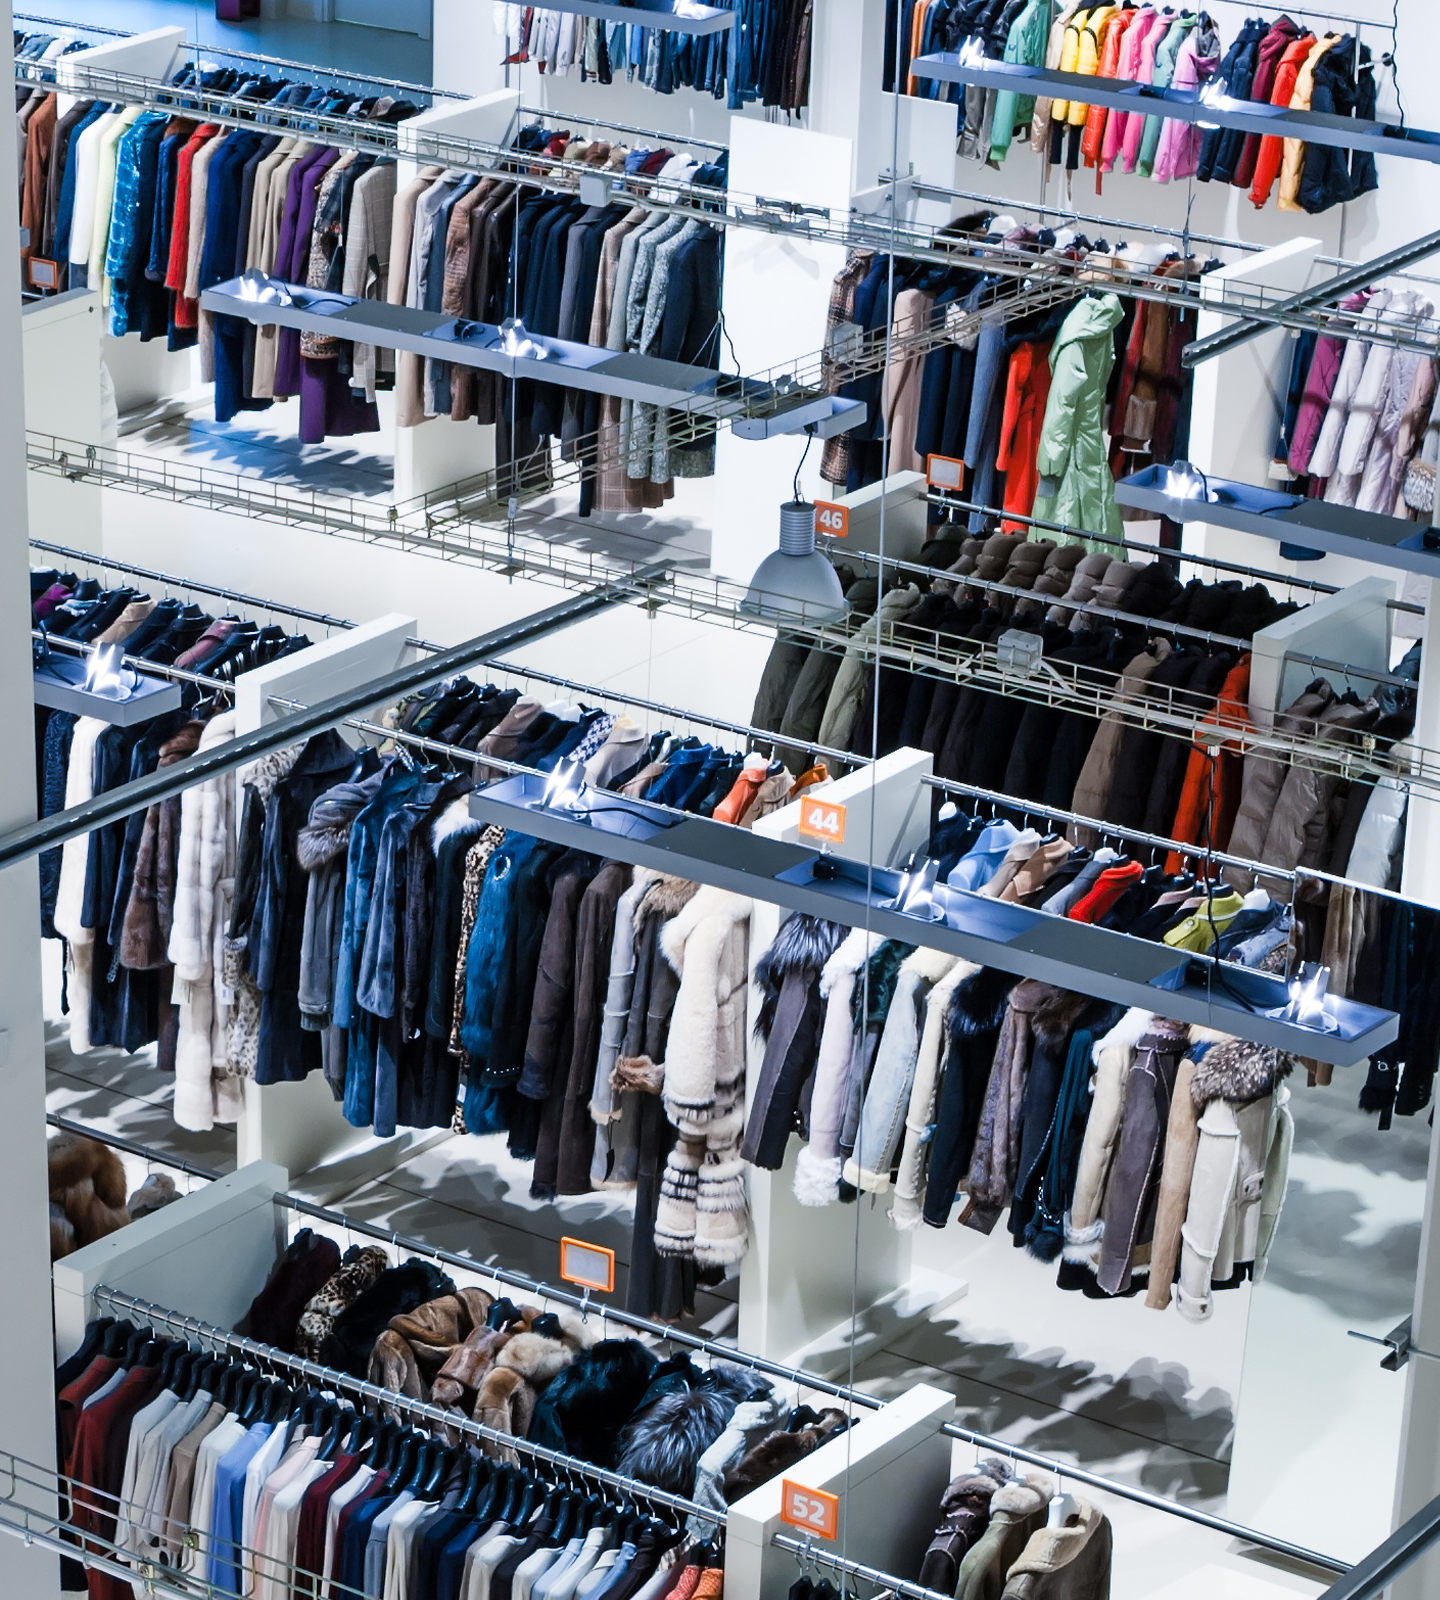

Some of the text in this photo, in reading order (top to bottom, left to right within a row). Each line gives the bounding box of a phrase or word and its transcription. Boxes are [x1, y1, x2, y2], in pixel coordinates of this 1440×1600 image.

[820, 509, 843, 530] 46
[808, 808, 839, 834] 44
[792, 1493, 825, 1526] 52
